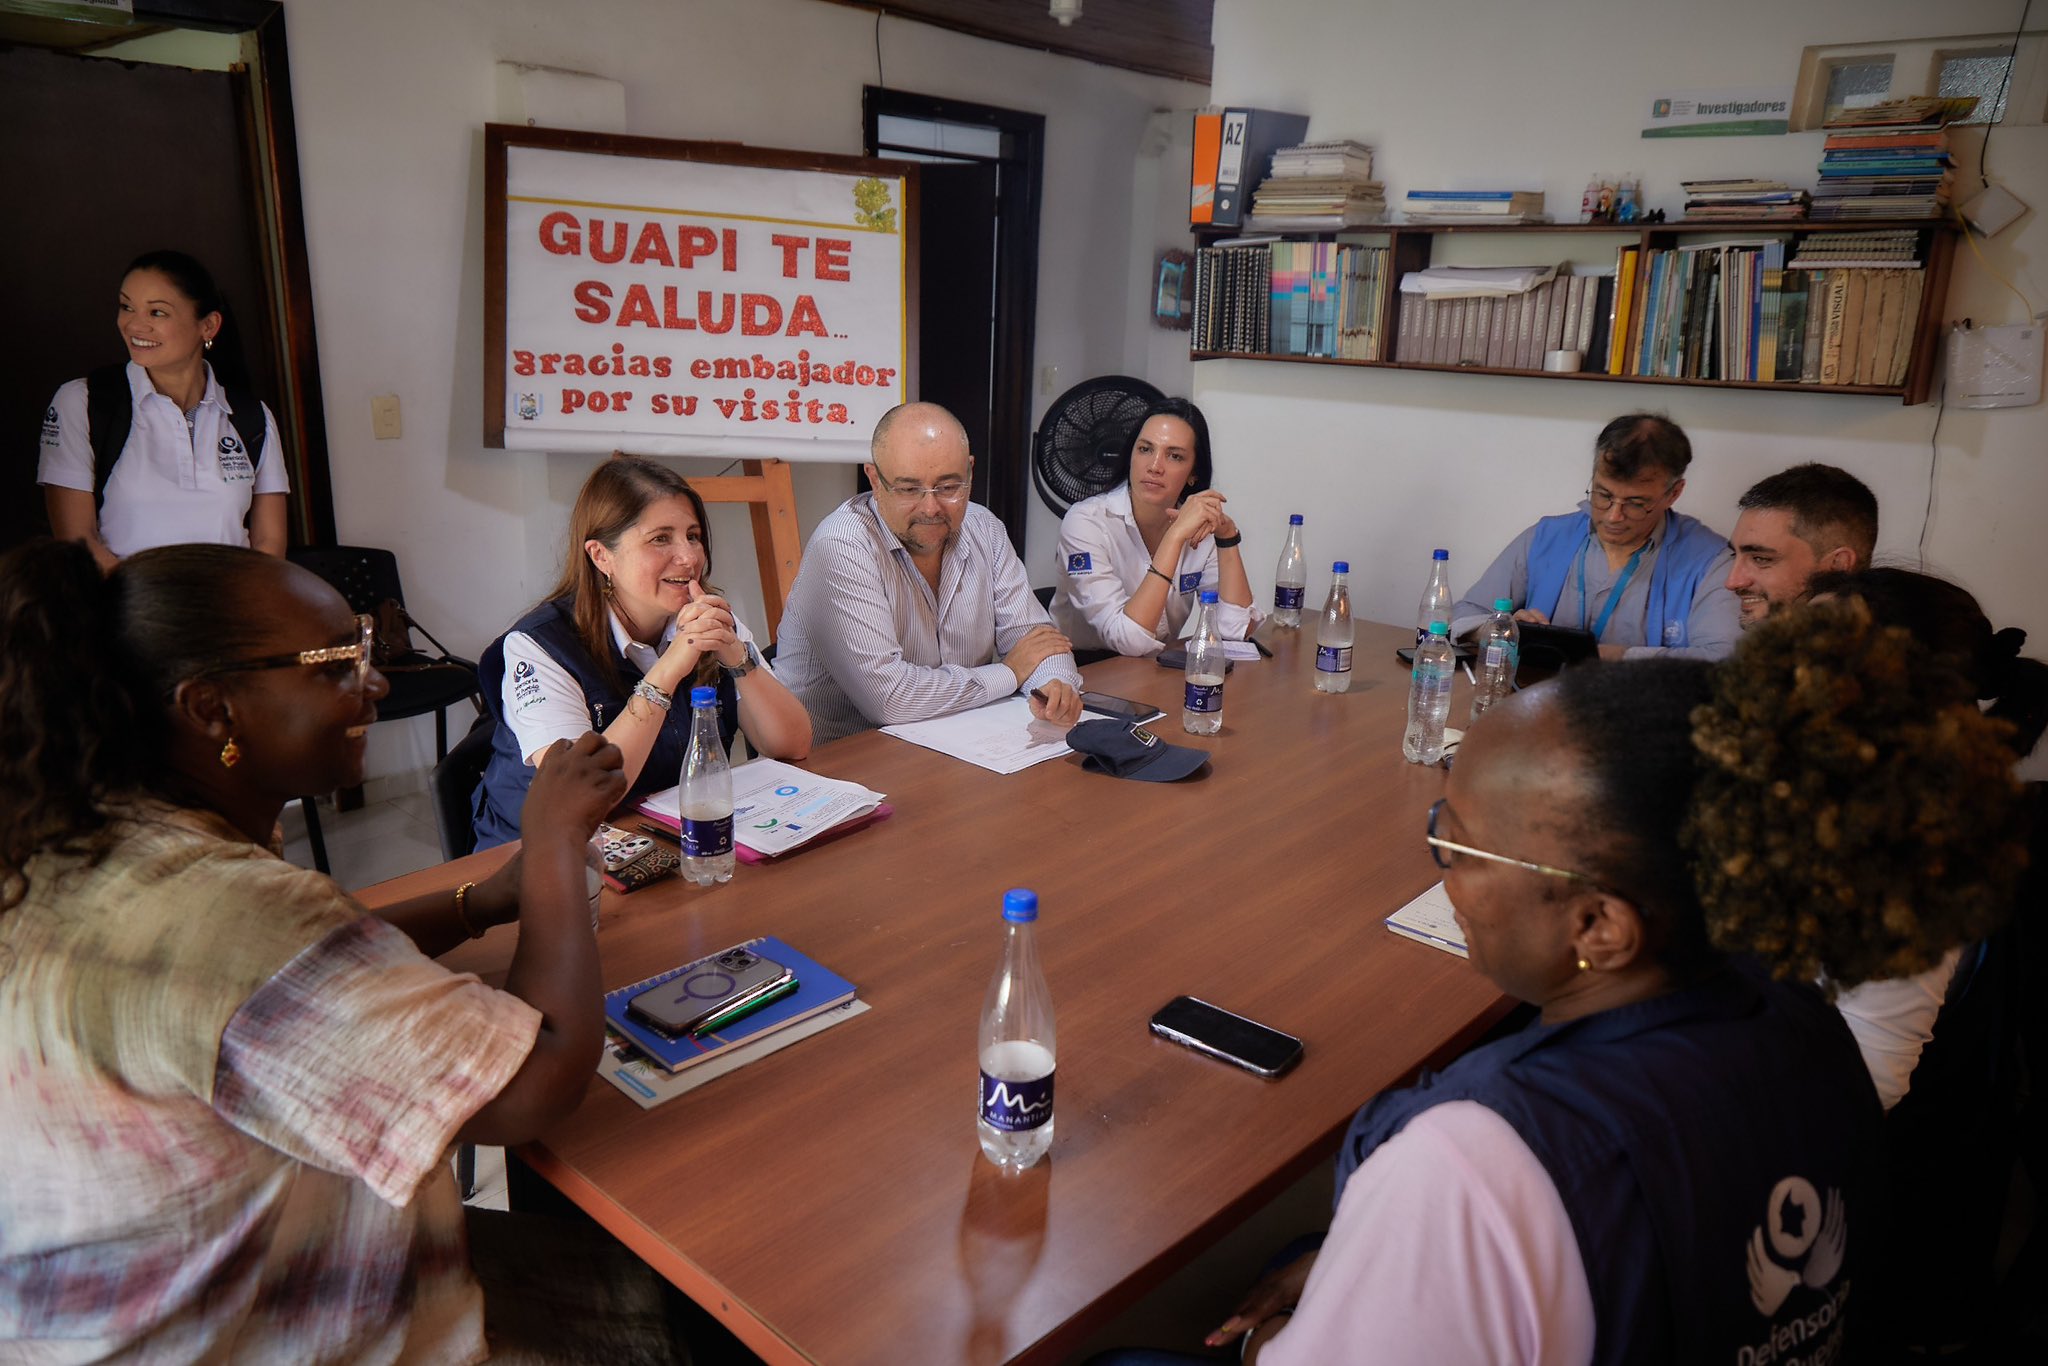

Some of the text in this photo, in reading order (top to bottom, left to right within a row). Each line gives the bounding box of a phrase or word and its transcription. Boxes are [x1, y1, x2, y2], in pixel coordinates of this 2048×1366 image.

[1697, 100, 1786, 115] Investigadores
[1225, 122, 1244, 146] AZ
[539, 211, 852, 282] GUAPI TE
[574, 280, 848, 339] SALUDA...
[1831, 284, 1844, 322] VISUAL
[690, 350, 897, 388] embajador
[561, 388, 855, 425] por su visita.
